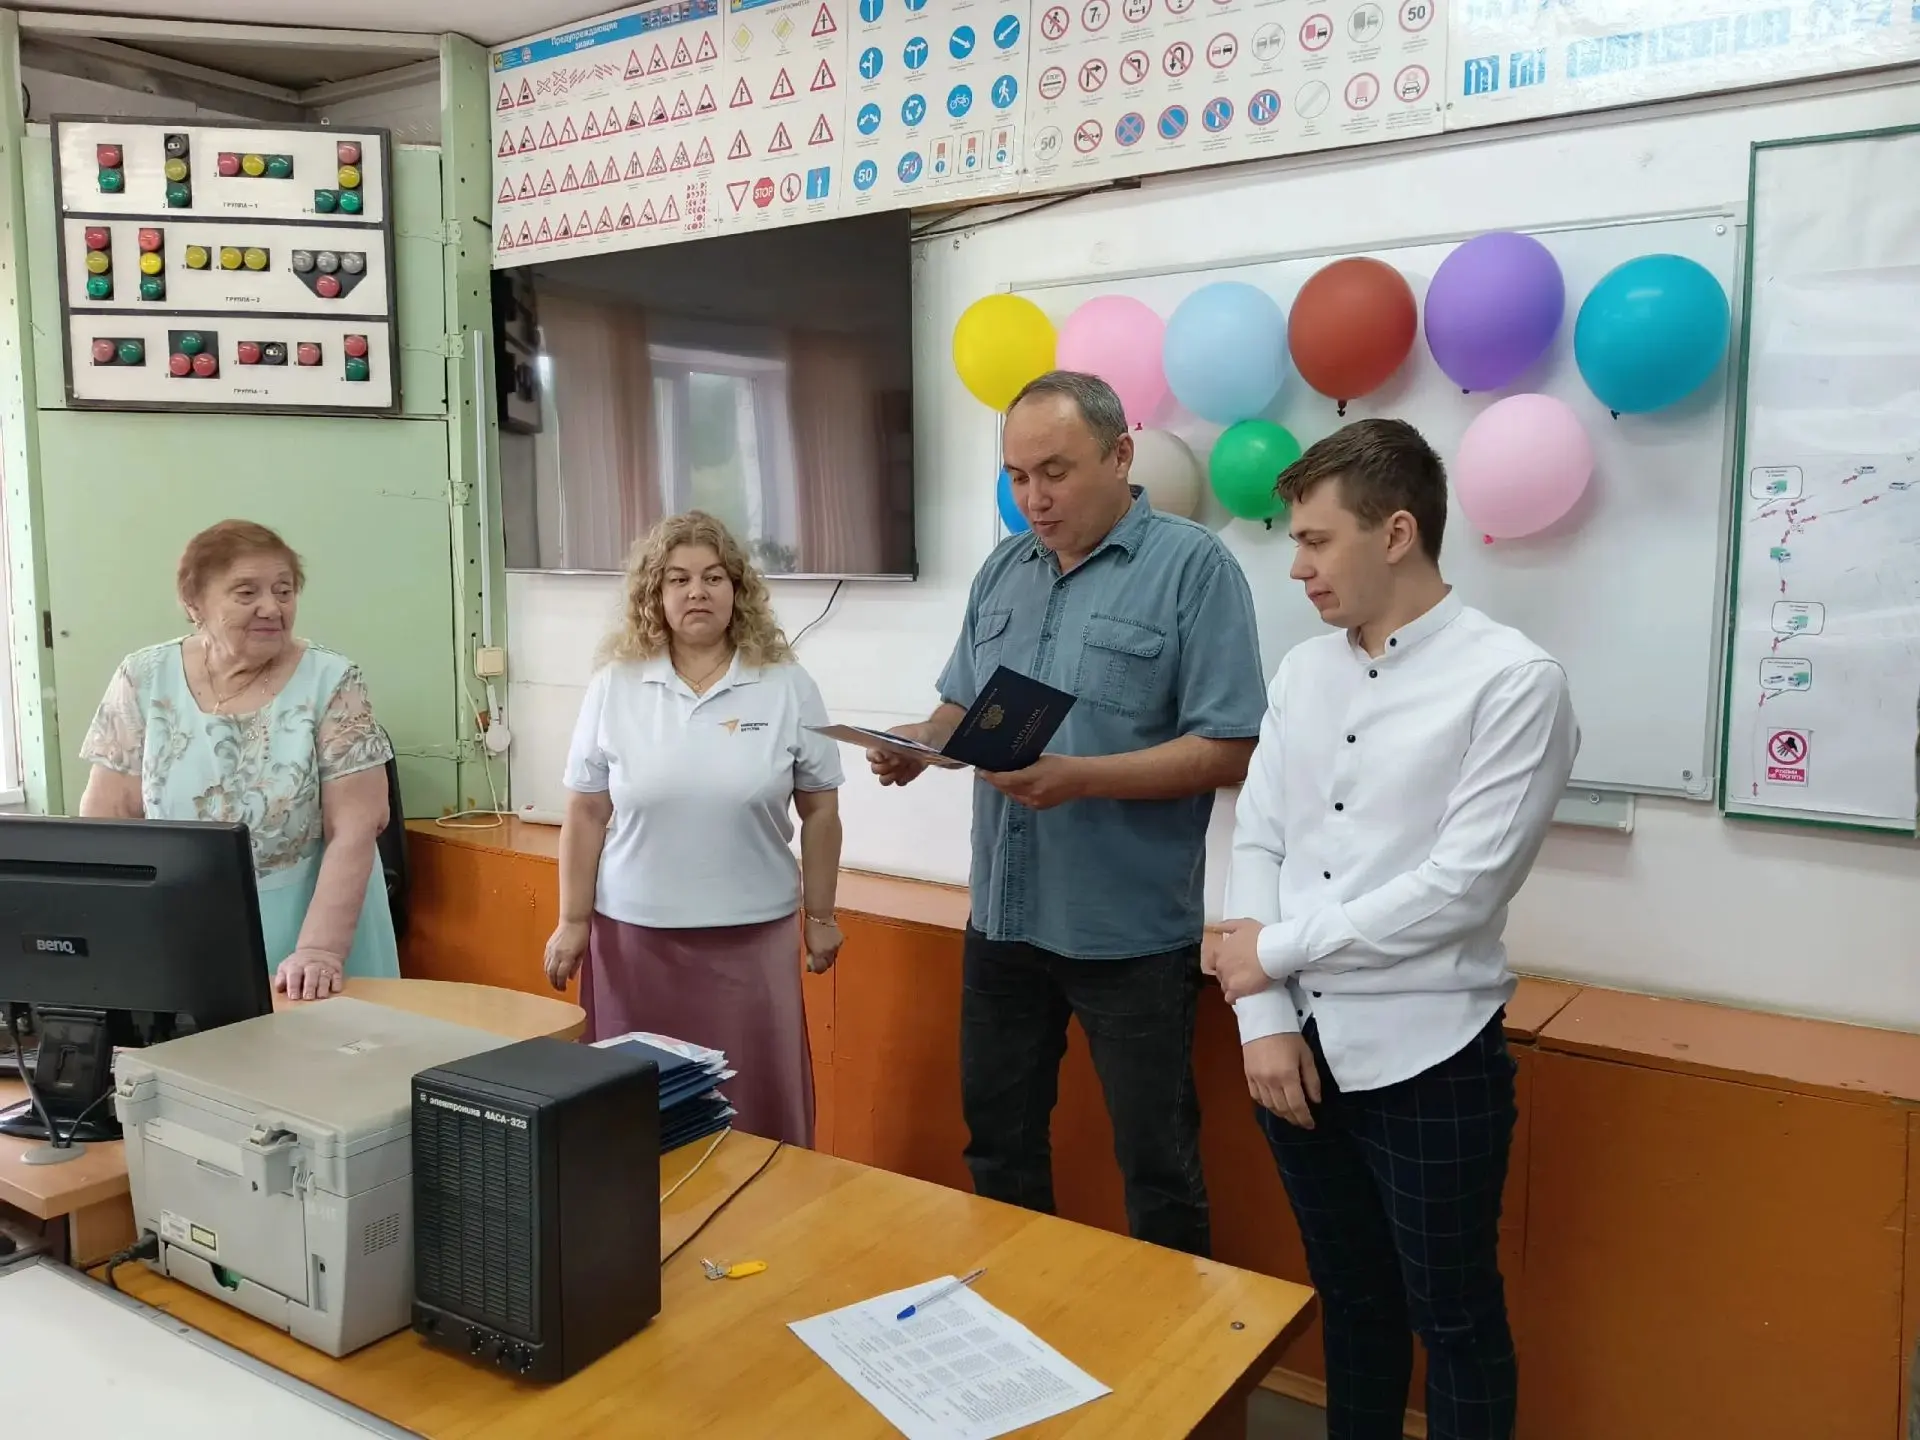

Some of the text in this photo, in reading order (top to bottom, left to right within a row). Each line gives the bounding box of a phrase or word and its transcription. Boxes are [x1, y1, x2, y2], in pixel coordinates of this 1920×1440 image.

[1407, 5, 1426, 21] 50
[551, 21, 618, 46] Предупреждающие
[1040, 135, 1056, 151] 50
[858, 167, 873, 183] 50
[754, 185, 773, 200] STOP
